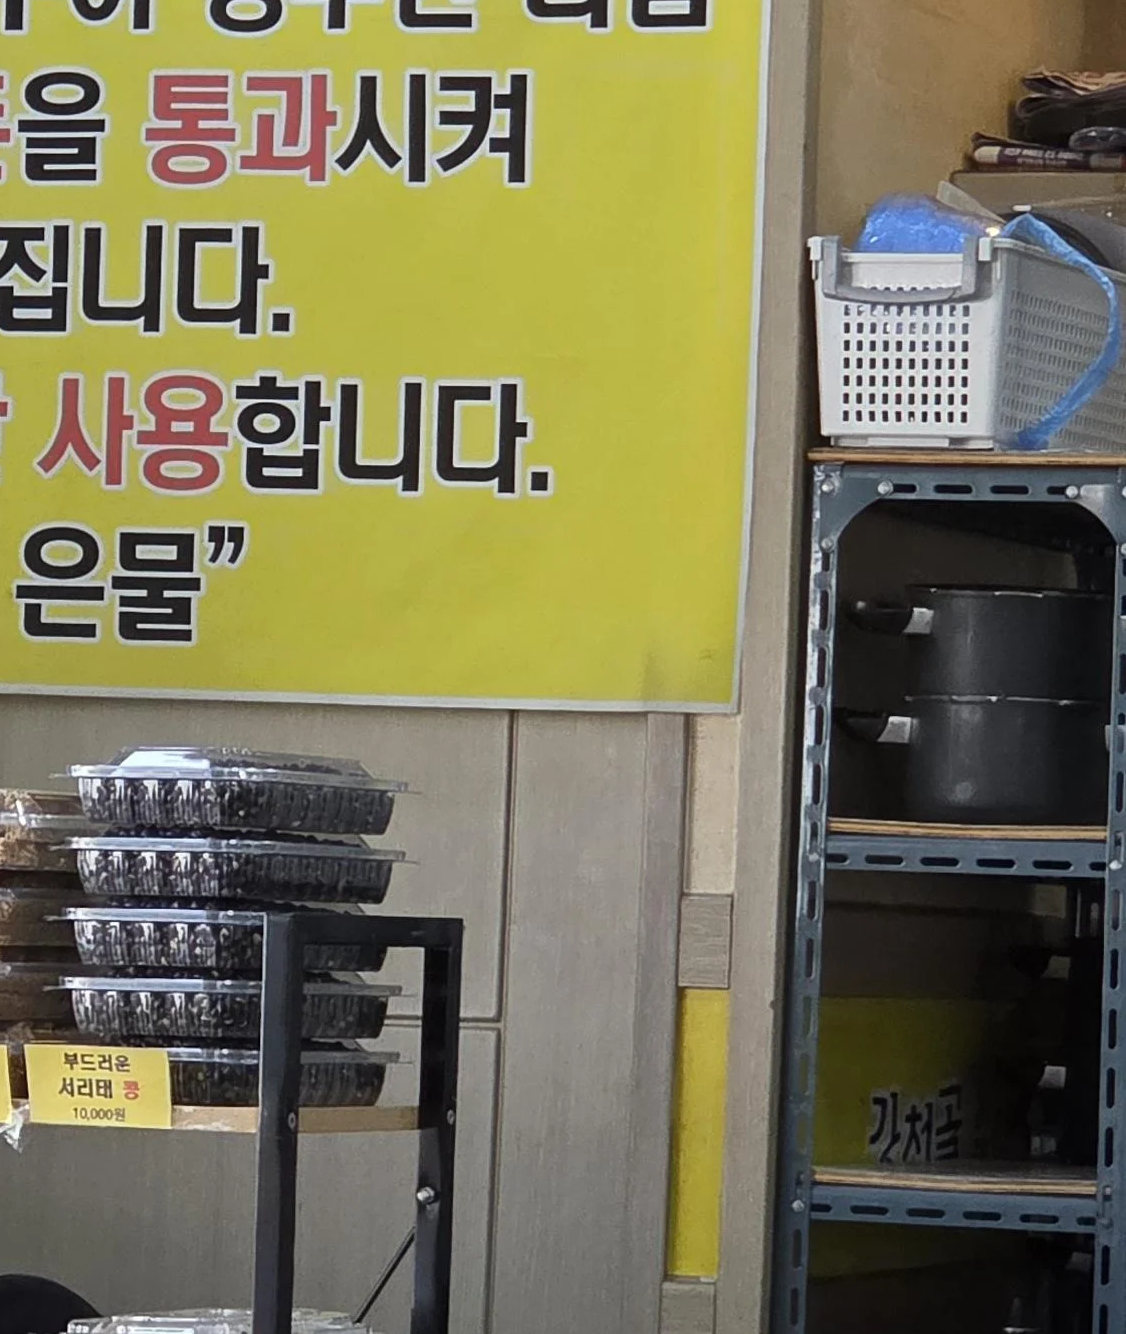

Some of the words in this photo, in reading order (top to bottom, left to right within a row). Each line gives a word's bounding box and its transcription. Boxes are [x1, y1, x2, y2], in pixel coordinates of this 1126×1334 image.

[148, 75, 527, 182] 통과시켜
[38, 377, 548, 493] 사용합니다.
[64, 1052, 131, 1072] 부드러운
[58, 1077, 113, 1099] 서리태
[123, 1080, 140, 1100] 콩
[73, 1106, 126, 1122] 10,000원
